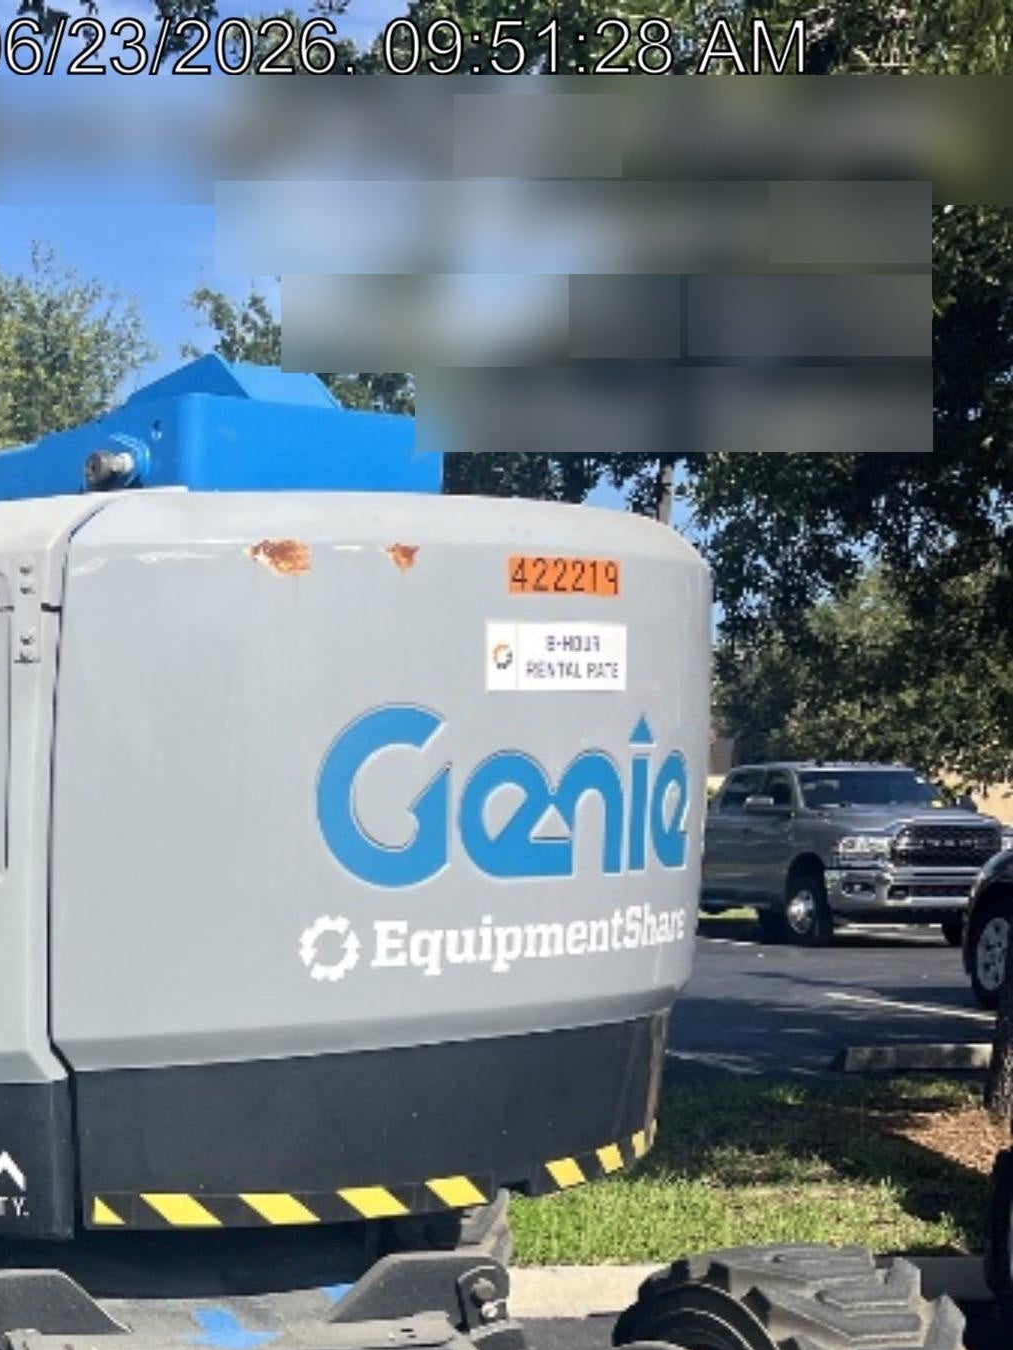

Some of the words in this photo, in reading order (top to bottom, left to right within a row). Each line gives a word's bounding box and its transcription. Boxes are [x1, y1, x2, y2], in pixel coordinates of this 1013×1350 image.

[510, 557, 620, 595] 422219
[526, 661, 582, 679] RENTAL
[587, 662, 619, 679] RATE
[316, 701, 690, 890] Genie
[371, 903, 686, 976] EquipmentShare
